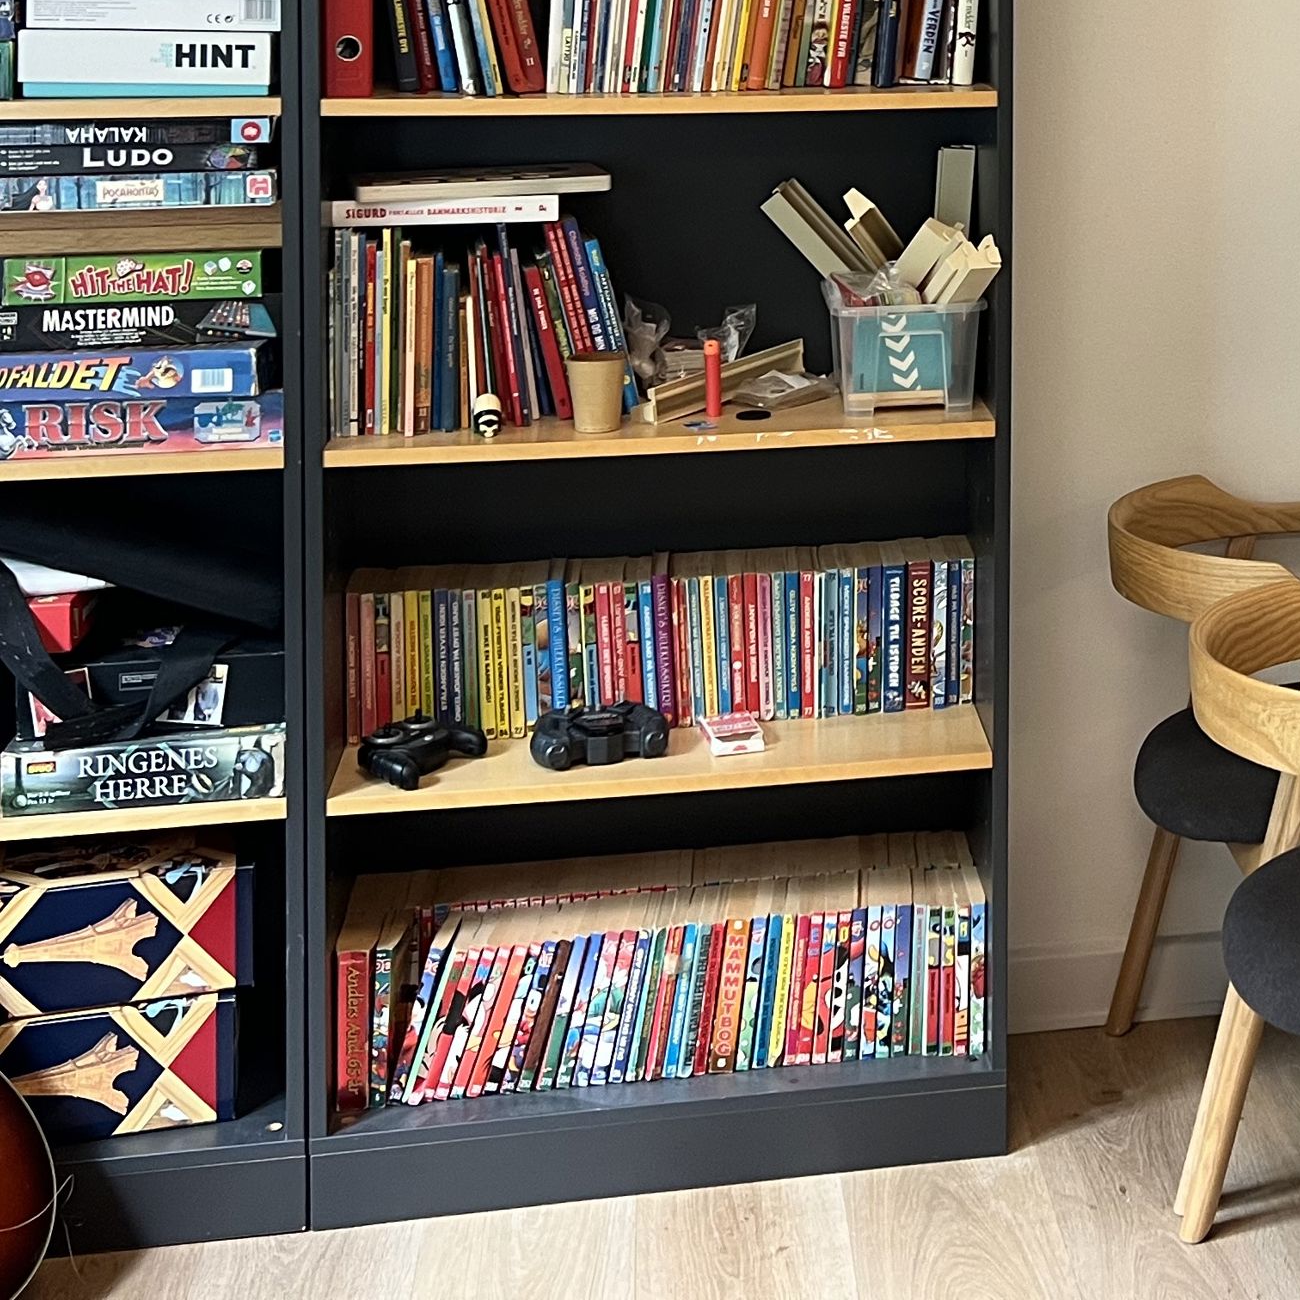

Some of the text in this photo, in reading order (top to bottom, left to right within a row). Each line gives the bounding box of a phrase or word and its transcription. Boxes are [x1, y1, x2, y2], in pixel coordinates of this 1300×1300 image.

[838, 2, 851, 39] VILDESTE
[922, 9, 939, 54] VERDEN
[175, 43, 256, 69] HINT
[836, 41, 846, 57] DYR
[65, 127, 147, 143] KALAHA
[82, 147, 174, 168] LUDO
[345, 207, 387, 219] SIGURD
[109, 278, 134, 293] THE
[43, 306, 175, 332] MASTERMIND
[22, 400, 168, 445] RISK
[888, 576, 900, 686] TILBAGE TIL ISTIDEN
[911, 578, 927, 674] SCORE-ANDEN
[644, 640, 652, 658] AND
[77, 746, 218, 778] RINGENES
[93, 775, 189, 802] HERRE
[348, 966, 364, 1017] Anders
[715, 934, 745, 1056] MAMMUTBOG
